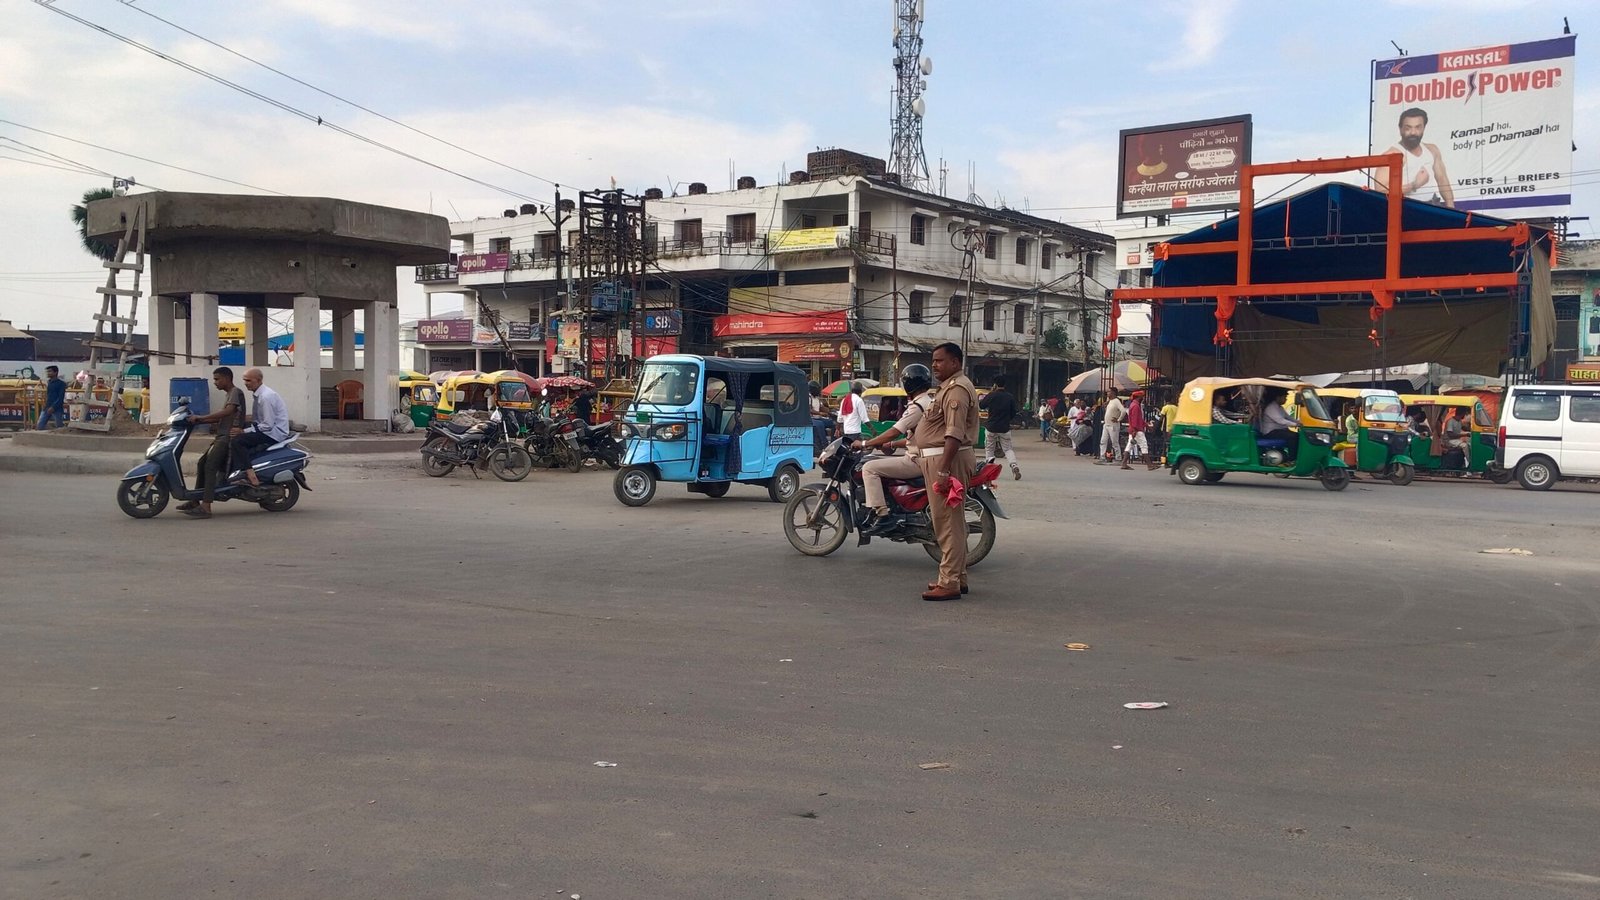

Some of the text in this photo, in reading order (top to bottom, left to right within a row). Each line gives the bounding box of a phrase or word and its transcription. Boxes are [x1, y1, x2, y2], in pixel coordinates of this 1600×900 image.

[1443, 51, 1504, 69] KANSAL
[1389, 68, 1562, 105] Double Power
[1450, 122, 1495, 139] Kamaal
[1453, 124, 1560, 150] body pe Dhamaal hai
[1214, 134, 1238, 144] भरोसा
[1128, 180, 1156, 195] कन्हैया
[1157, 180, 1178, 192] लाल
[1206, 170, 1238, 186] ज्वेलर्स
[1457, 172, 1560, 186] VESTS BRIEFS
[1480, 184, 1535, 195] DRAWERS
[462, 255, 487, 271] apollo
[420, 321, 449, 339] apollo
[729, 320, 763, 329] mahindra
[1569, 368, 1599, 380] चाहत
